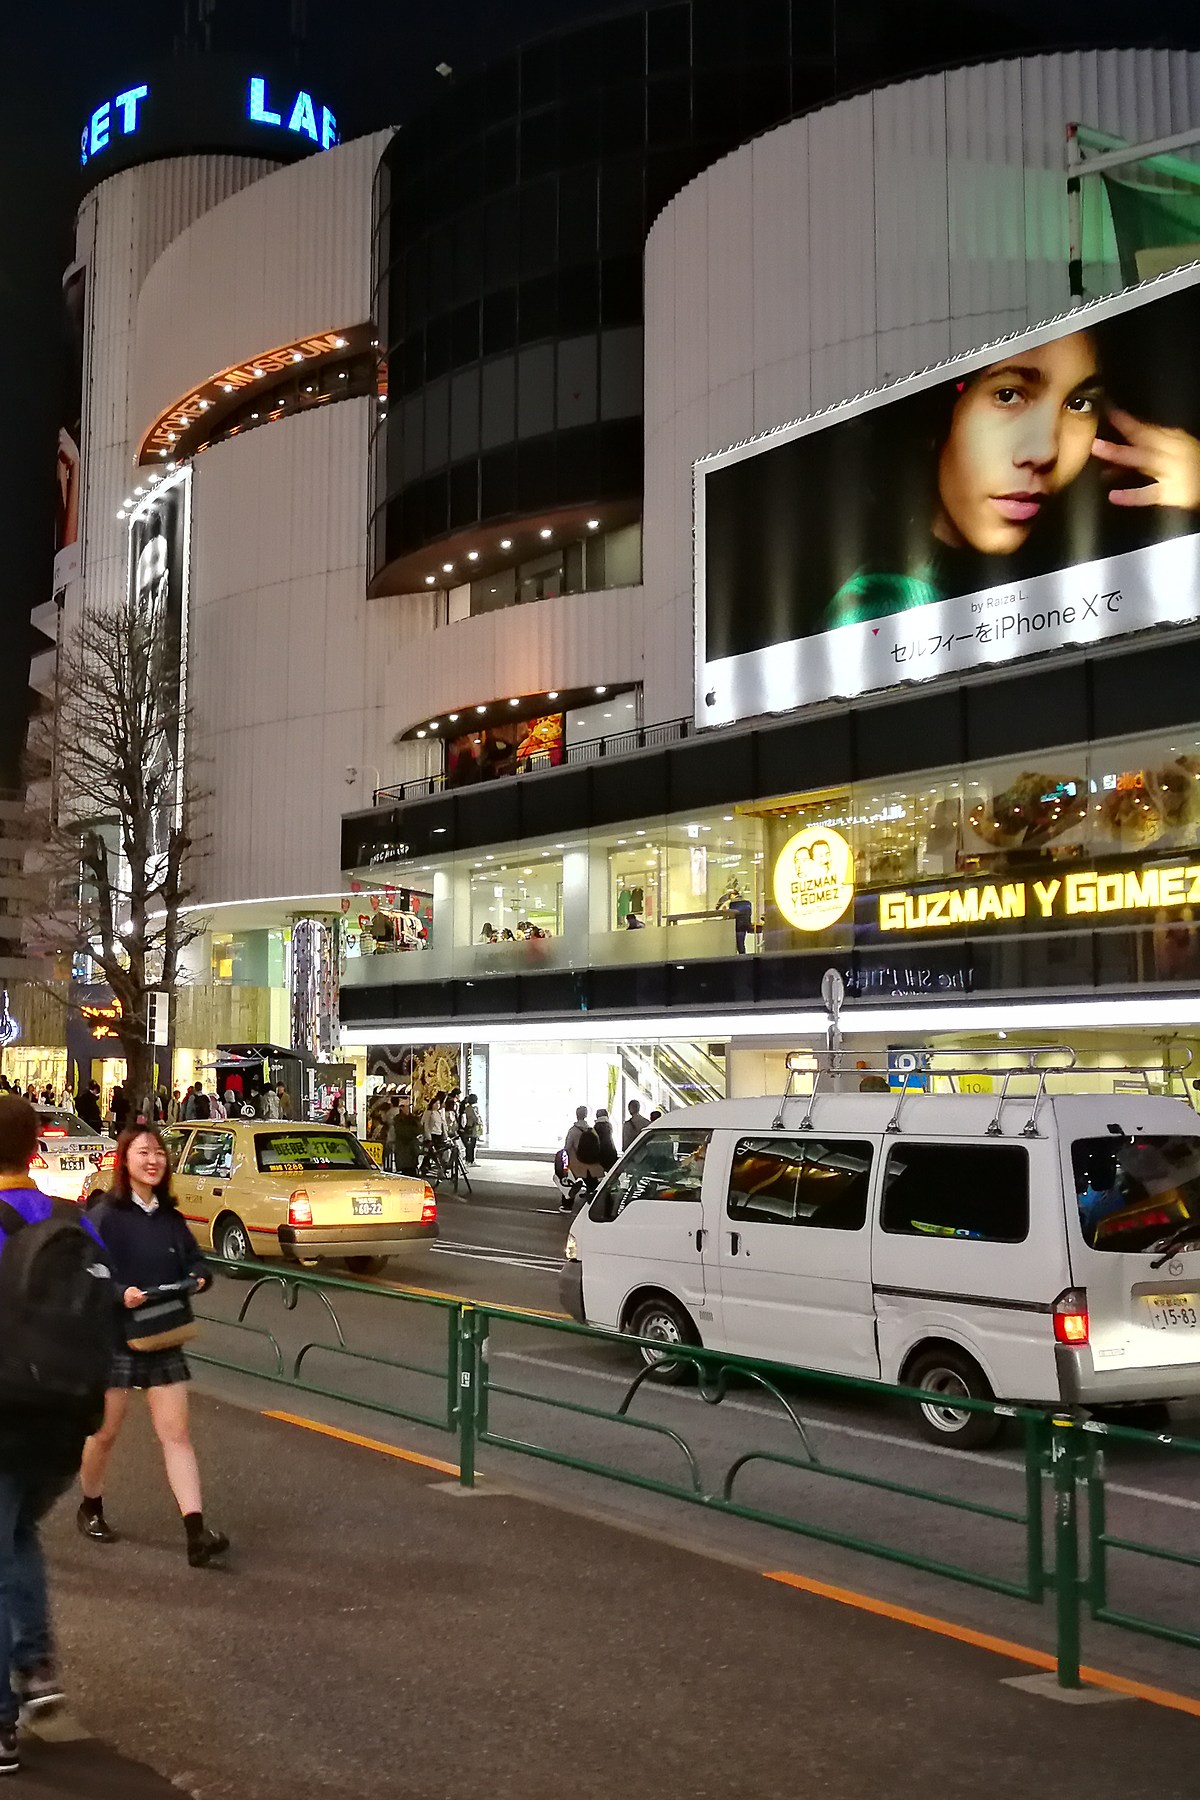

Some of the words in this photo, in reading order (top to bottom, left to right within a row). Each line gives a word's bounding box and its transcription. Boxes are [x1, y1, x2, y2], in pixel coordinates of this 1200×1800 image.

[146, 393, 217, 455] LAFORET
[213, 333, 350, 391] MUSEUM
[970, 601, 984, 613] by
[791, 875, 837, 894] GUZMAN
[801, 888, 839, 905] GOMEZ
[880, 882, 1026, 931] GUZMAN
[1033, 879, 1062, 917] Y
[1162, 1308, 1197, 1326] 15-83
